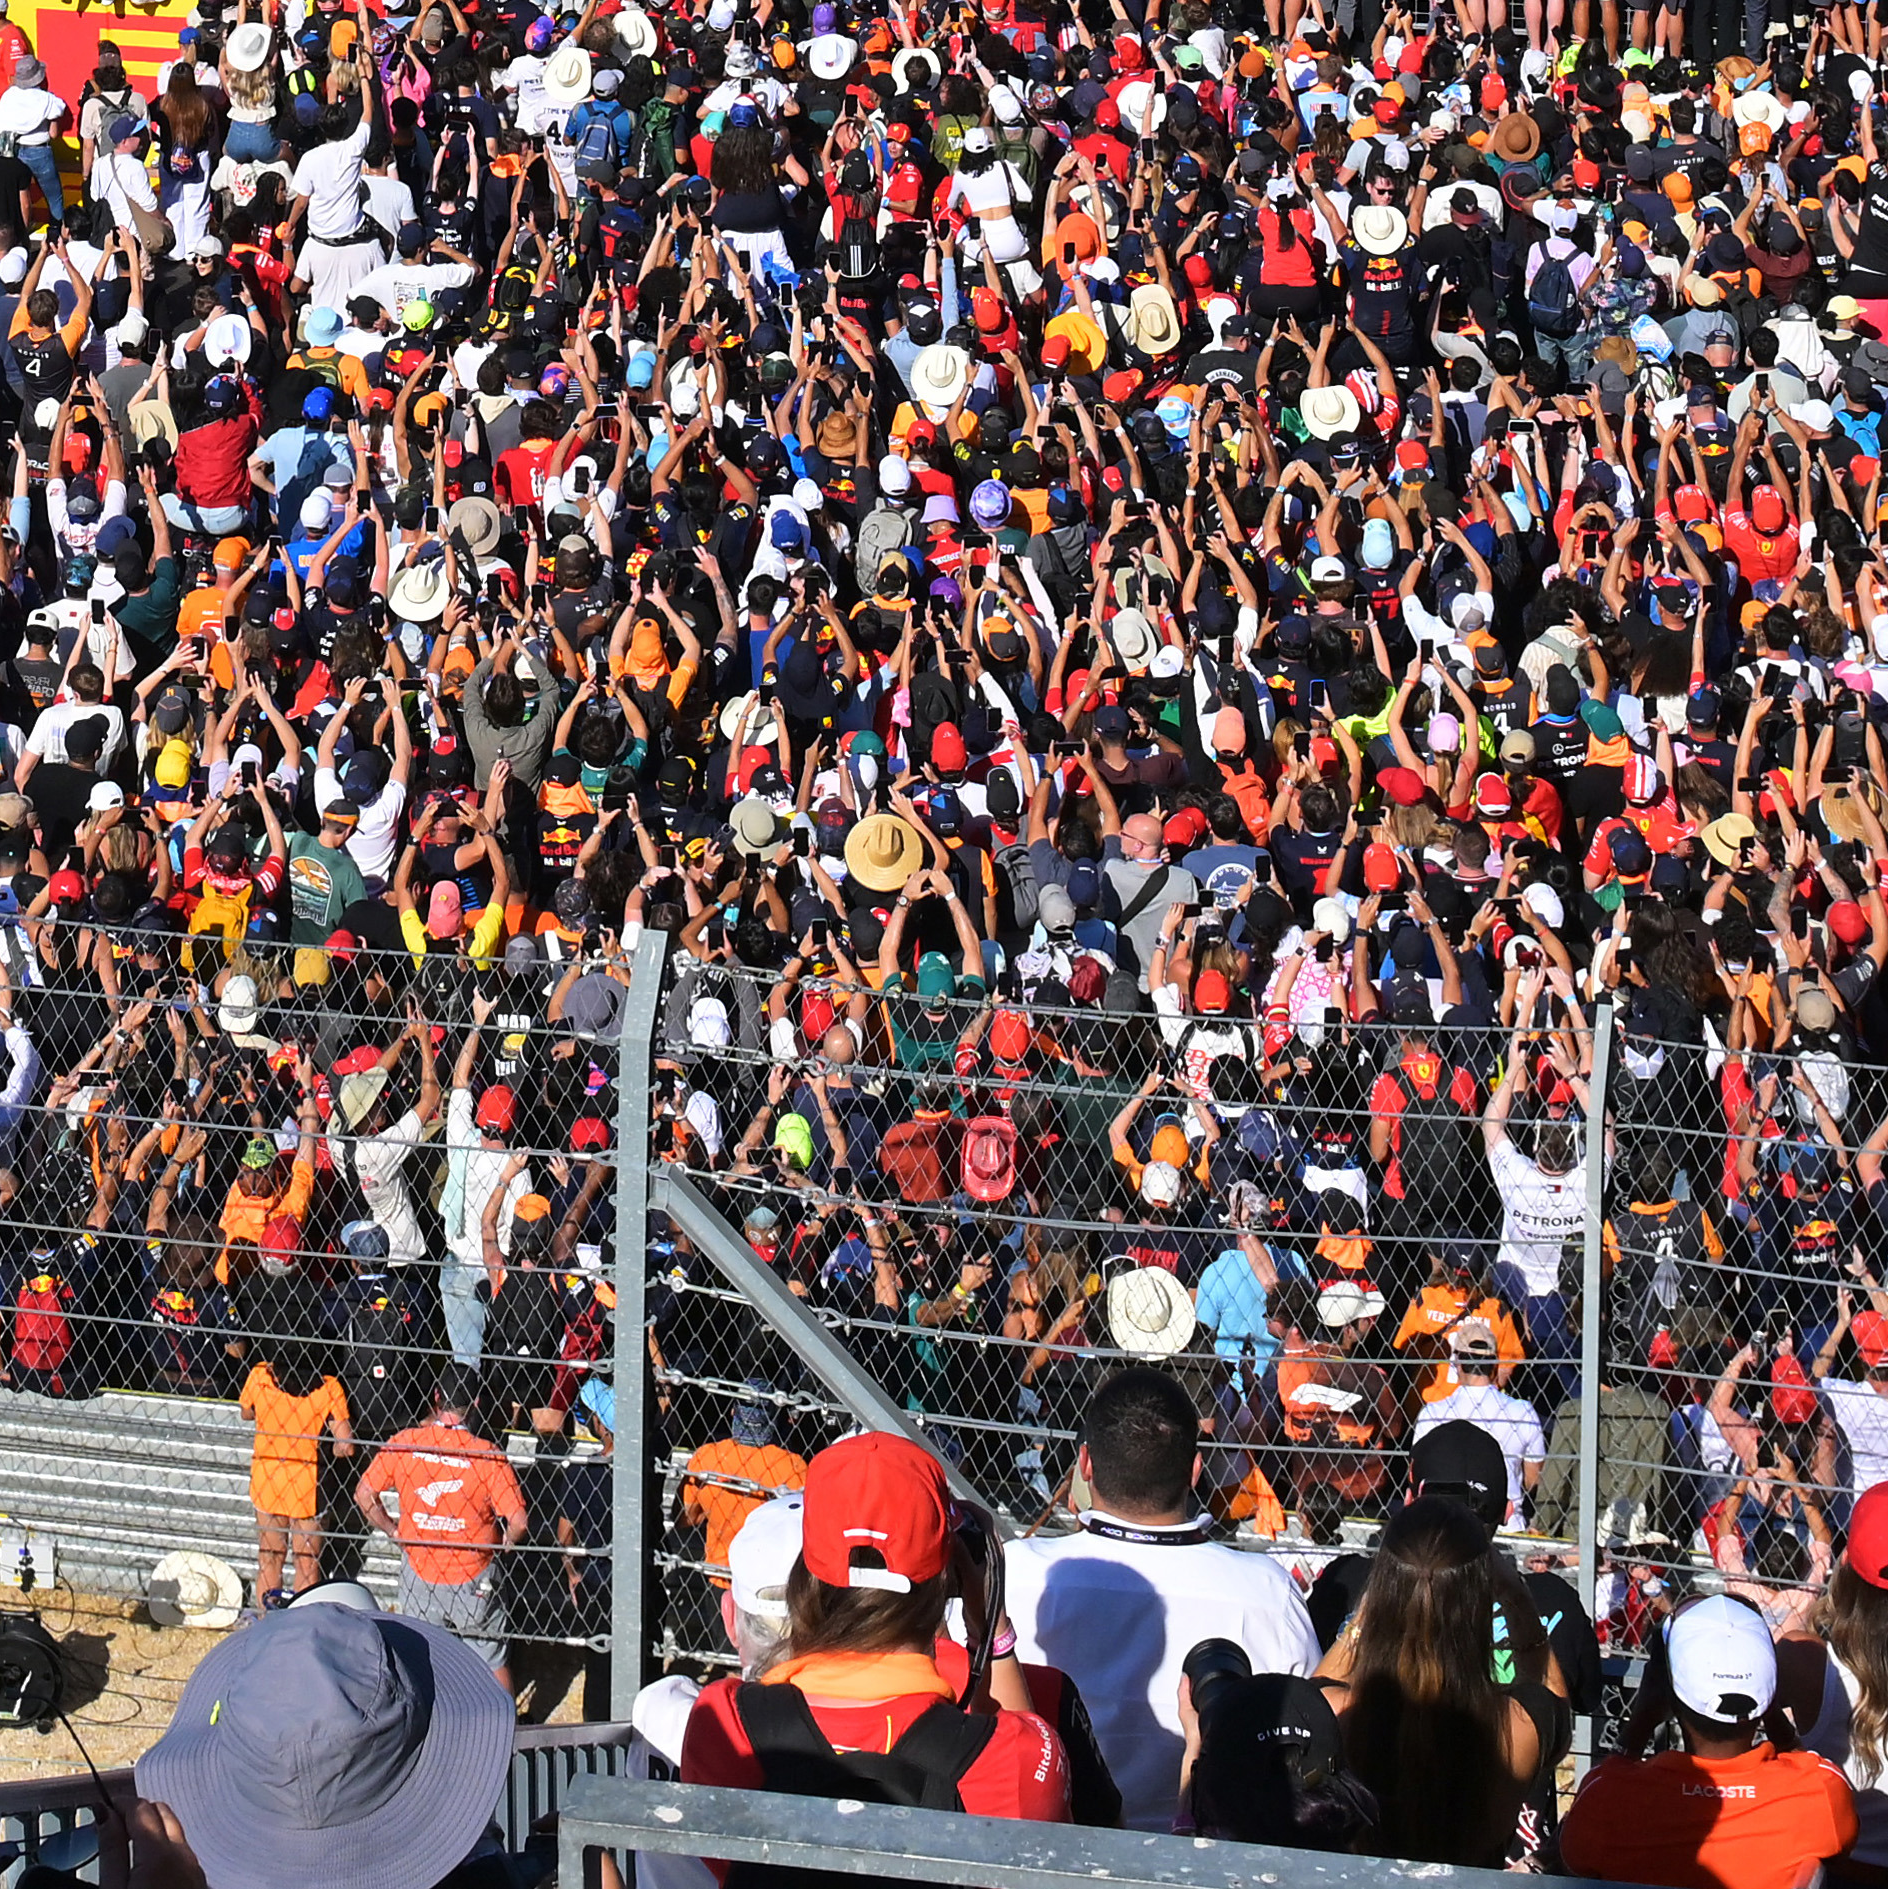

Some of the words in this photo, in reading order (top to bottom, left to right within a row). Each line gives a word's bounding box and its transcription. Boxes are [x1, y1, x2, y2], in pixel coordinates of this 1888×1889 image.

[26, 359, 41, 377] 4
[1492, 712, 1512, 732] 4
[1512, 1210, 1585, 1227] PETRONA
[1713, 1672, 1743, 1680] Formula
[1256, 1726, 1290, 1741] GIVE
[1295, 1726, 1313, 1737] UP
[1682, 1783, 1756, 1799] LACOSTE
